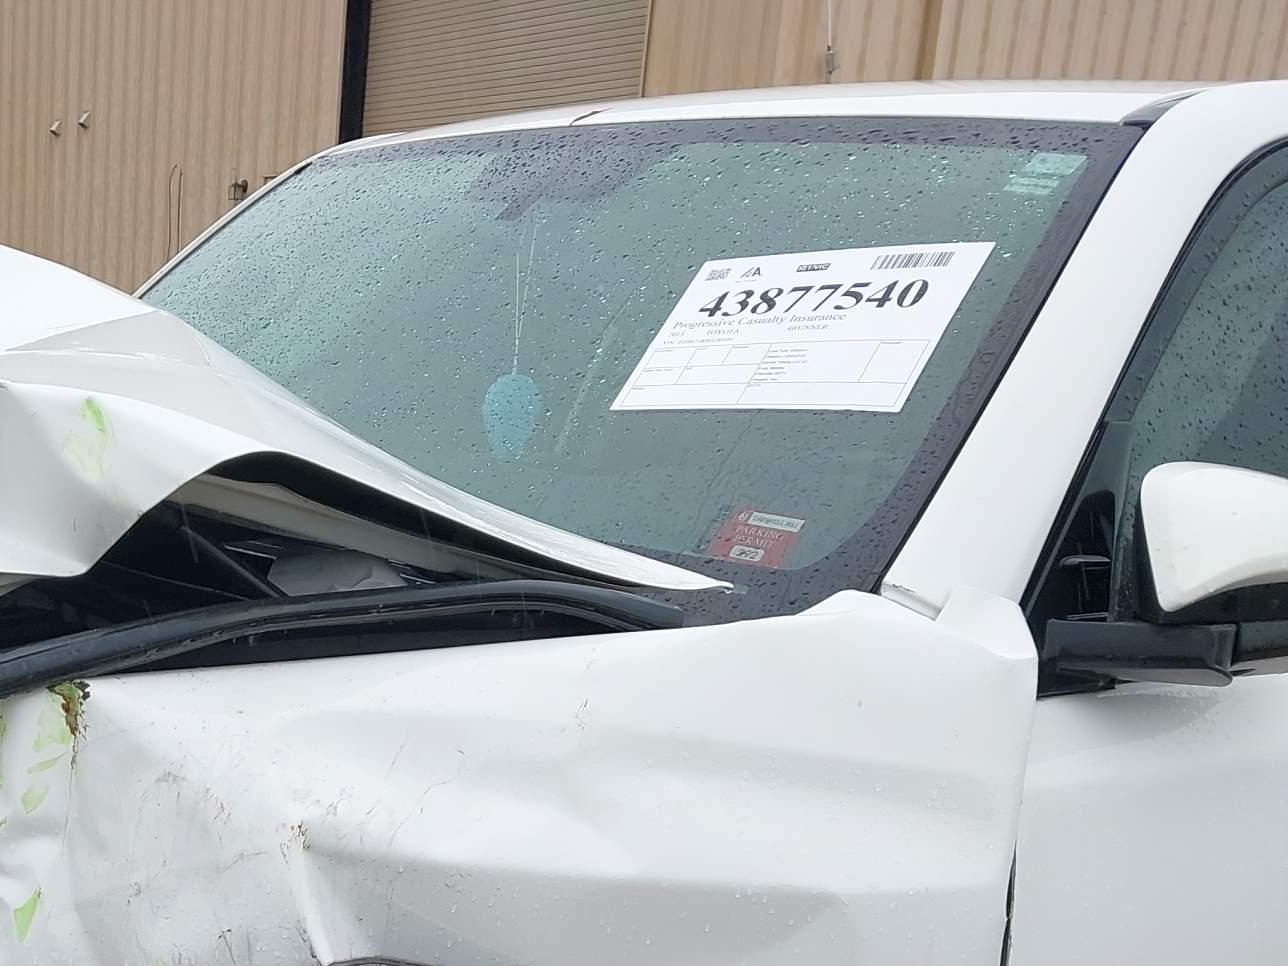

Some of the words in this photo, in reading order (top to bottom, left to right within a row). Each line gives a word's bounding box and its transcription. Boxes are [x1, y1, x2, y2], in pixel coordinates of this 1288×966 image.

[698, 279, 929, 318] 43877540
[673, 318, 736, 329] Progressive
[738, 315, 787, 325] Casualty
[789, 313, 848, 323] Insurance
